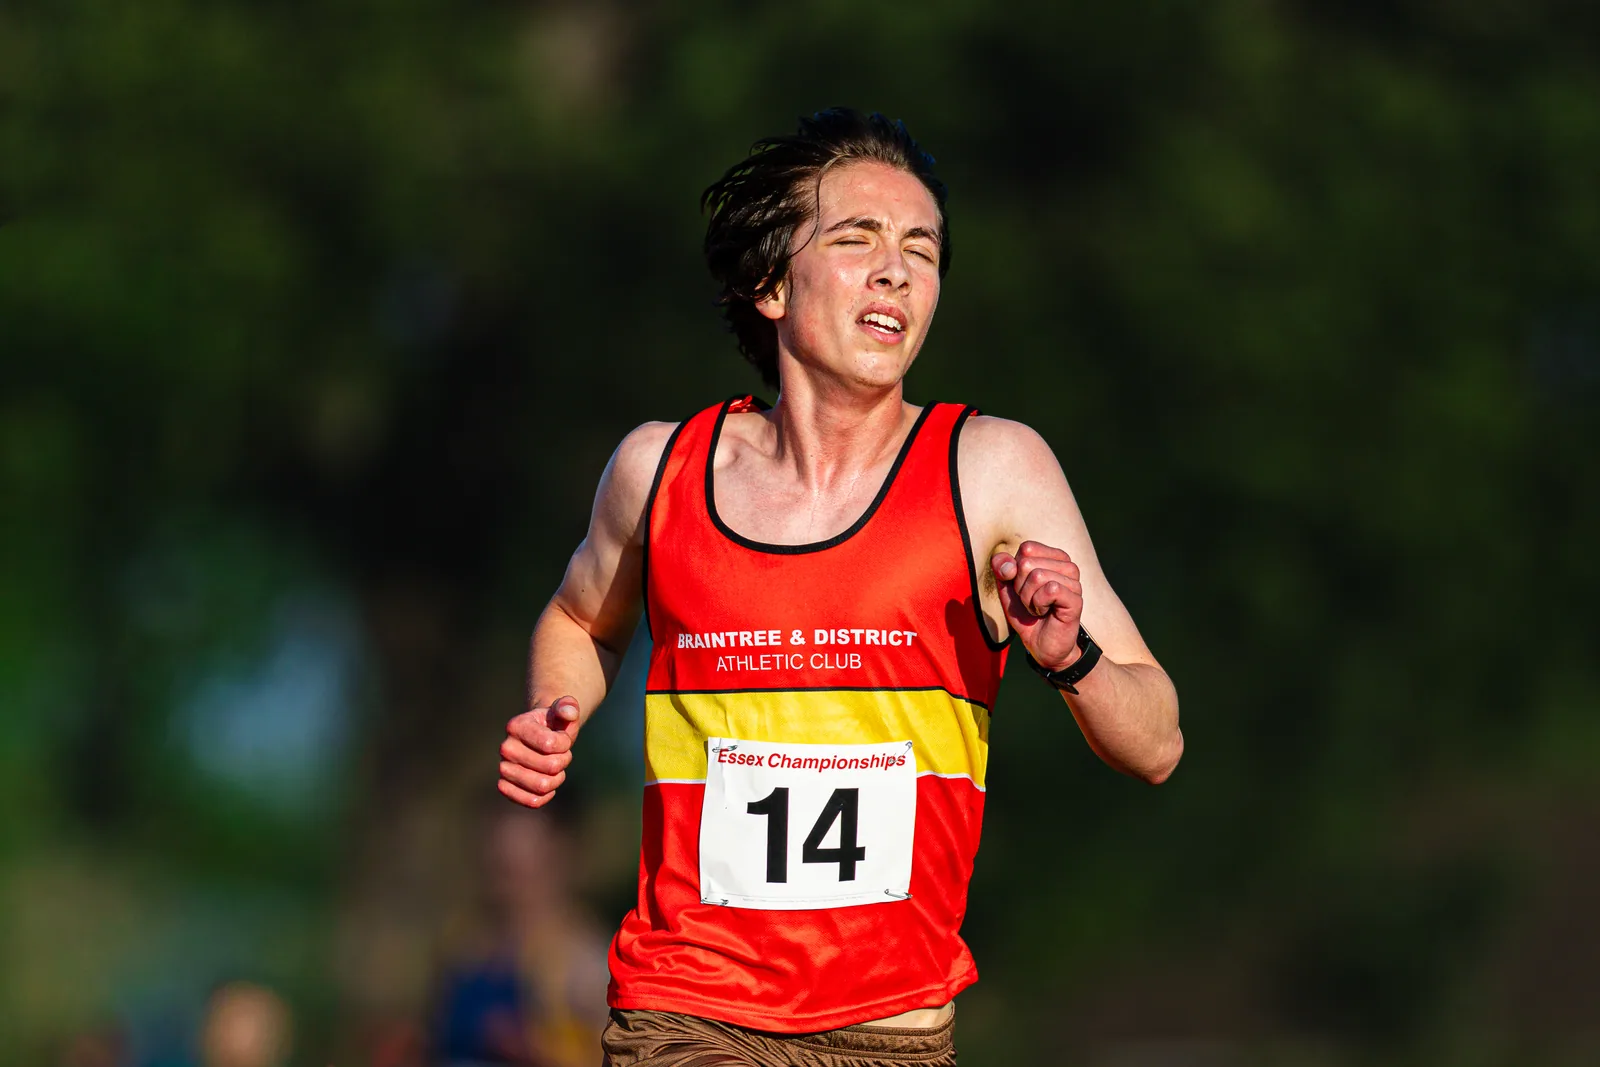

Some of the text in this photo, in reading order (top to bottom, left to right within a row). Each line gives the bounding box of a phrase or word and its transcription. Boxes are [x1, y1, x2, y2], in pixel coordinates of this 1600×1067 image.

[677, 629, 917, 649] BRAINTREE & DISTRICT
[716, 653, 862, 671] ATHLETIC CLUB
[717, 748, 906, 773] Essex Championships
[746, 786, 866, 883] 14
